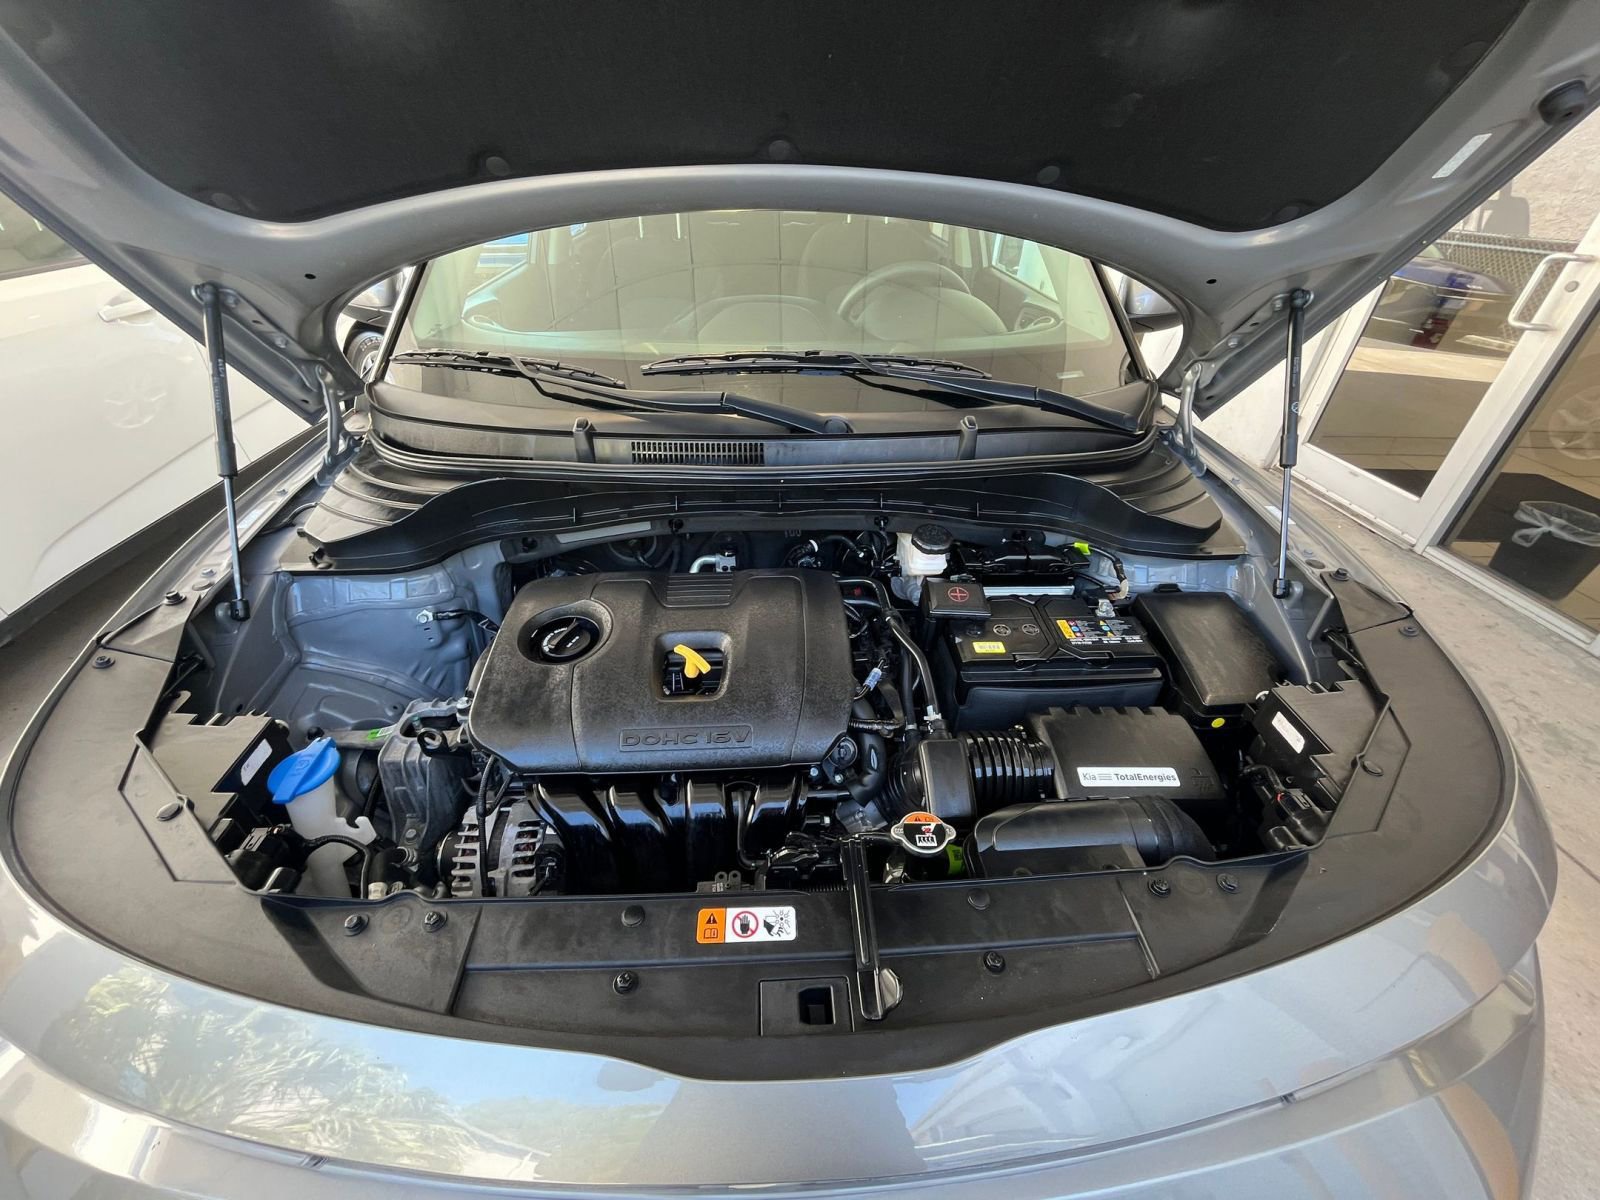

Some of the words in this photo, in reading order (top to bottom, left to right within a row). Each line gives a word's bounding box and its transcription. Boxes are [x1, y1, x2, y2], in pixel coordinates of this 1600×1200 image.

[622, 732, 699, 747] DOHC
[705, 729, 750, 744] 16V
[1082, 772, 1097, 781] Kia
[1113, 772, 1177, 783] TotalEnergies
